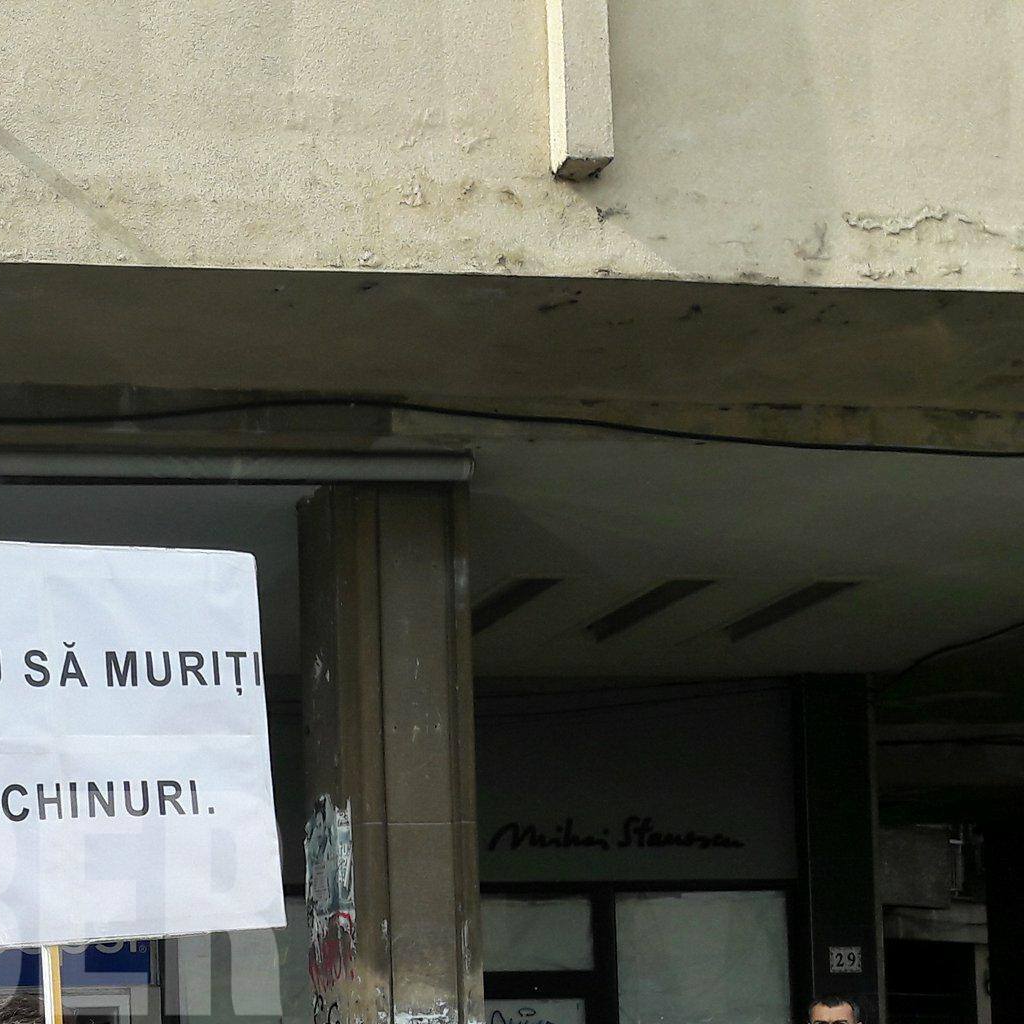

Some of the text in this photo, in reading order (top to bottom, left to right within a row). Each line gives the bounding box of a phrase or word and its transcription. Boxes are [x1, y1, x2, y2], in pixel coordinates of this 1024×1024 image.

[24, 641, 89, 688] SĂ
[105, 650, 263, 696] MURIȚI
[1, 779, 216, 823] CHINURI.
[835, 951, 857, 968] 29
